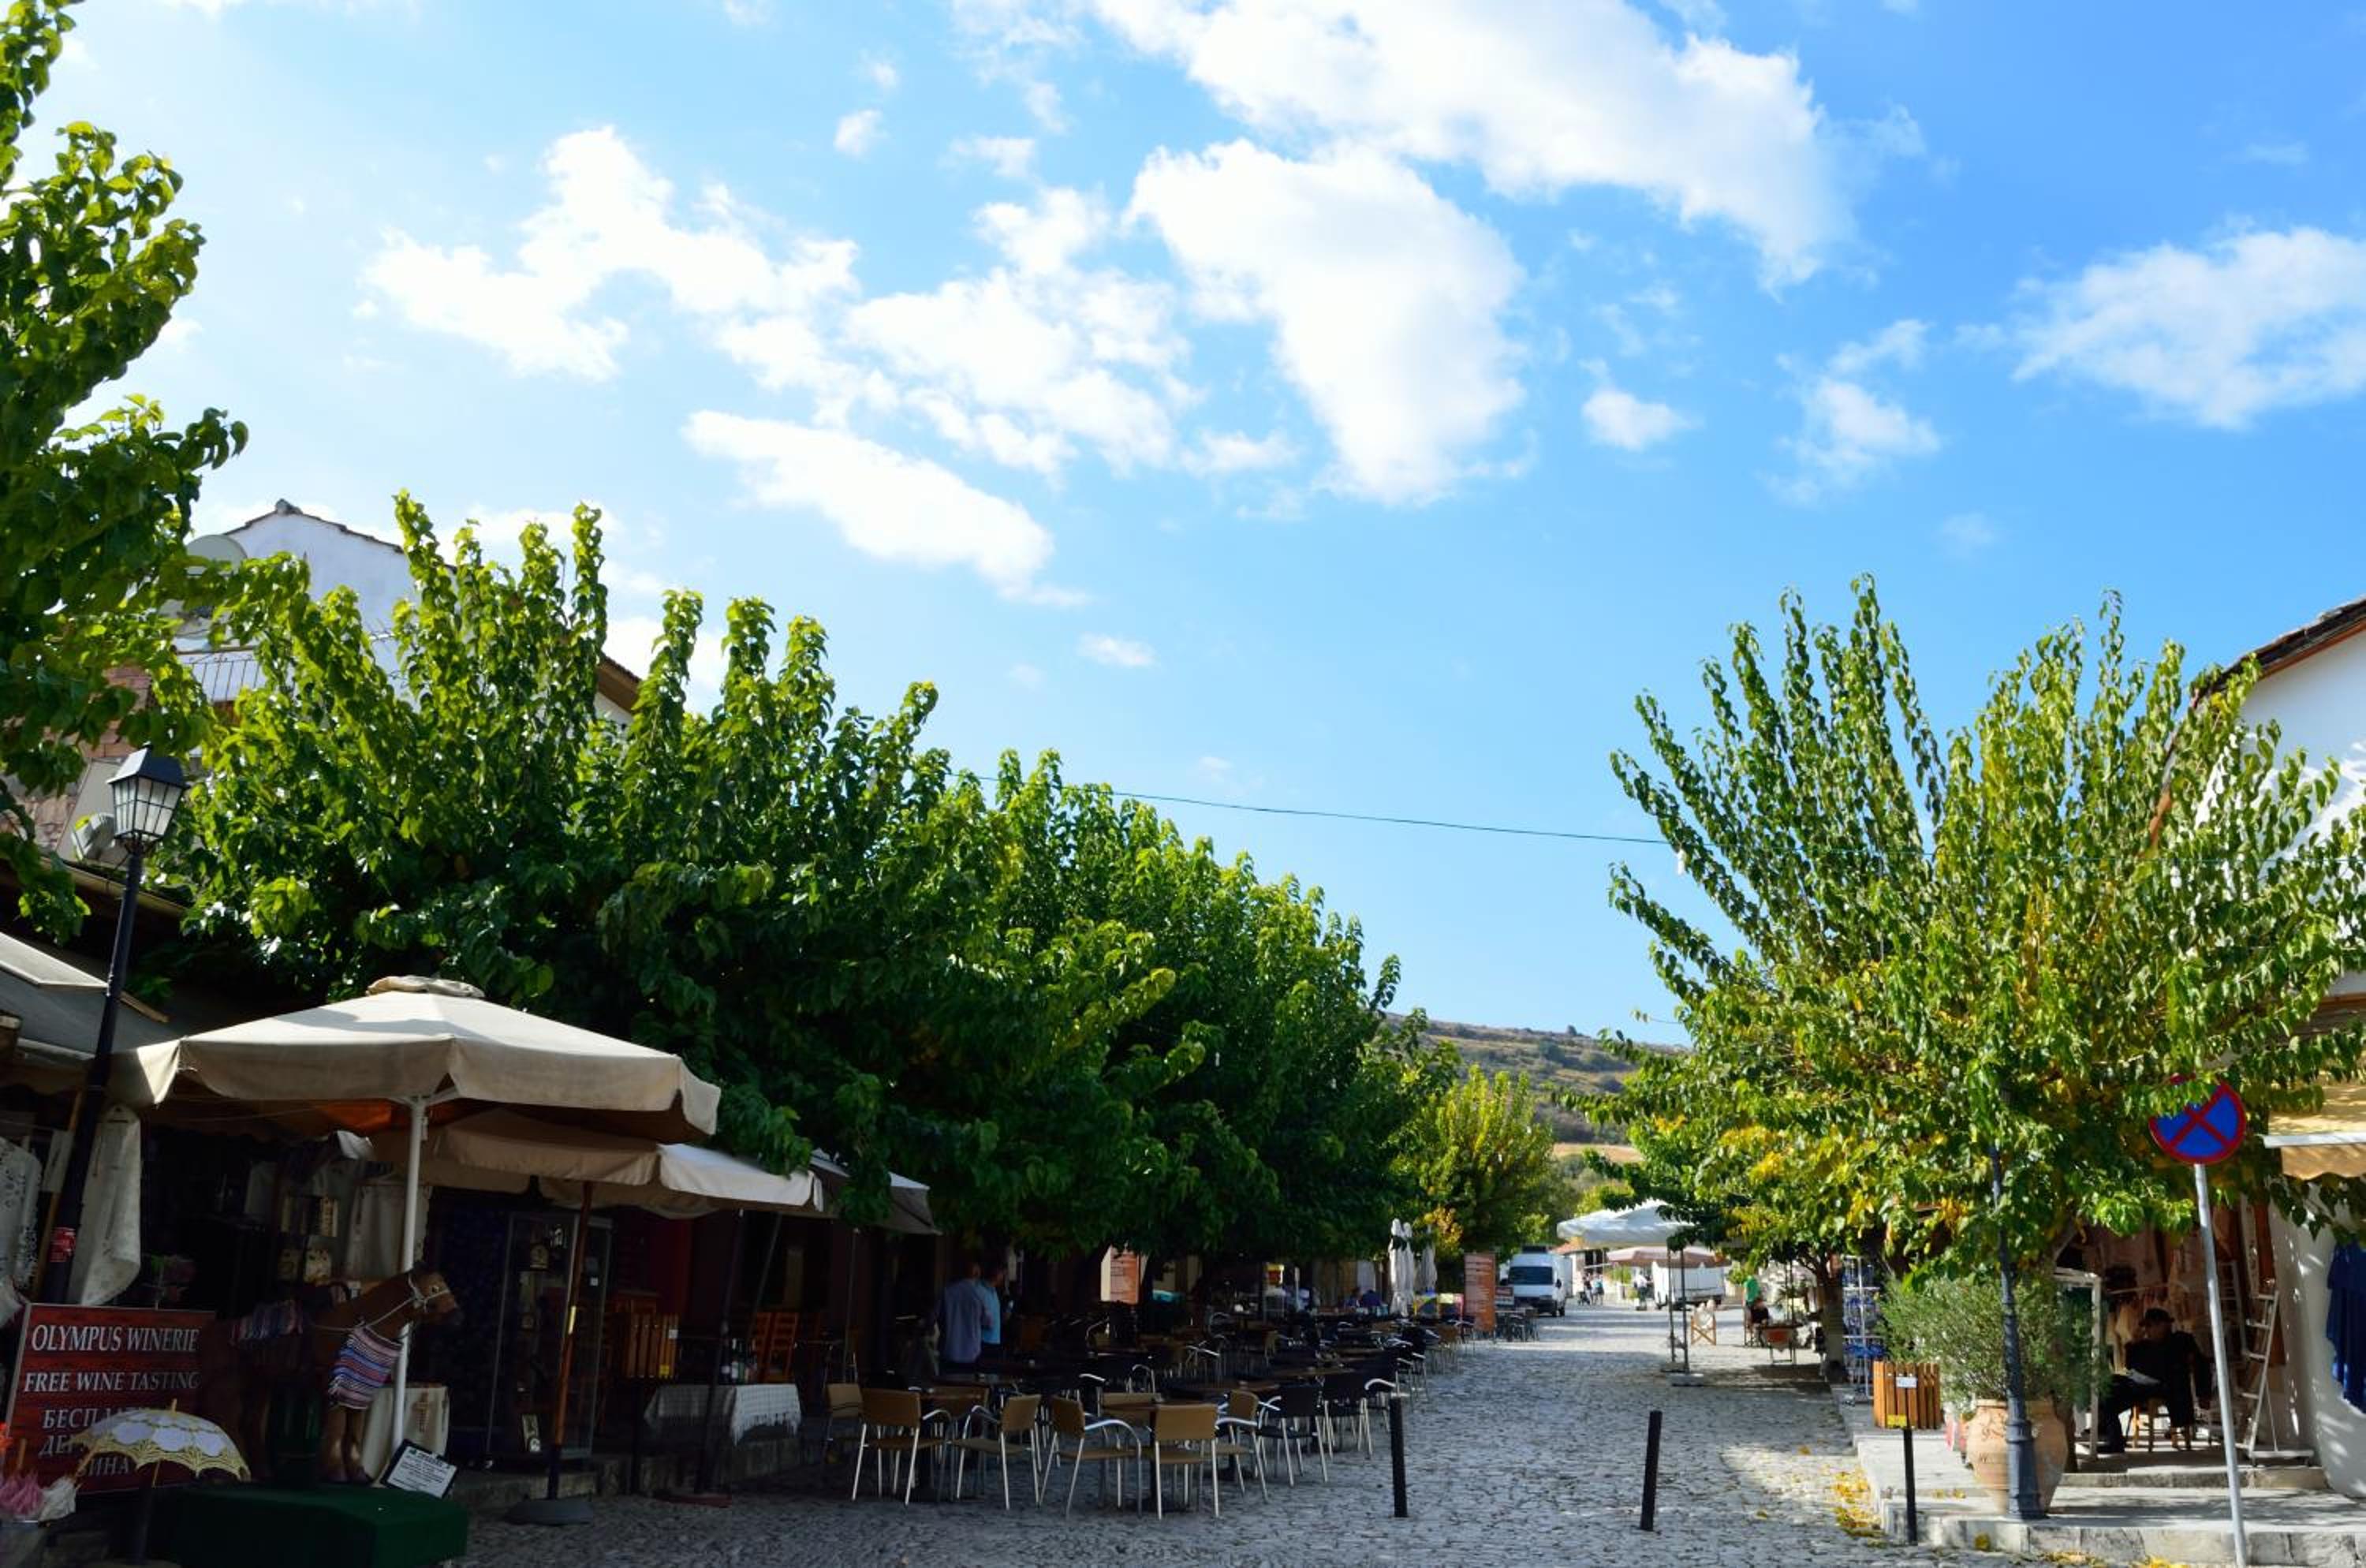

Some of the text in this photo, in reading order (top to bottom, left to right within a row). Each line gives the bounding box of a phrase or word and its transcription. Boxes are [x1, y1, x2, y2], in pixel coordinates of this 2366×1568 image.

[31, 1324, 122, 1351] OLYMPUS
[24, 1372, 71, 1392] FREE
[77, 1371, 125, 1391] WINE
